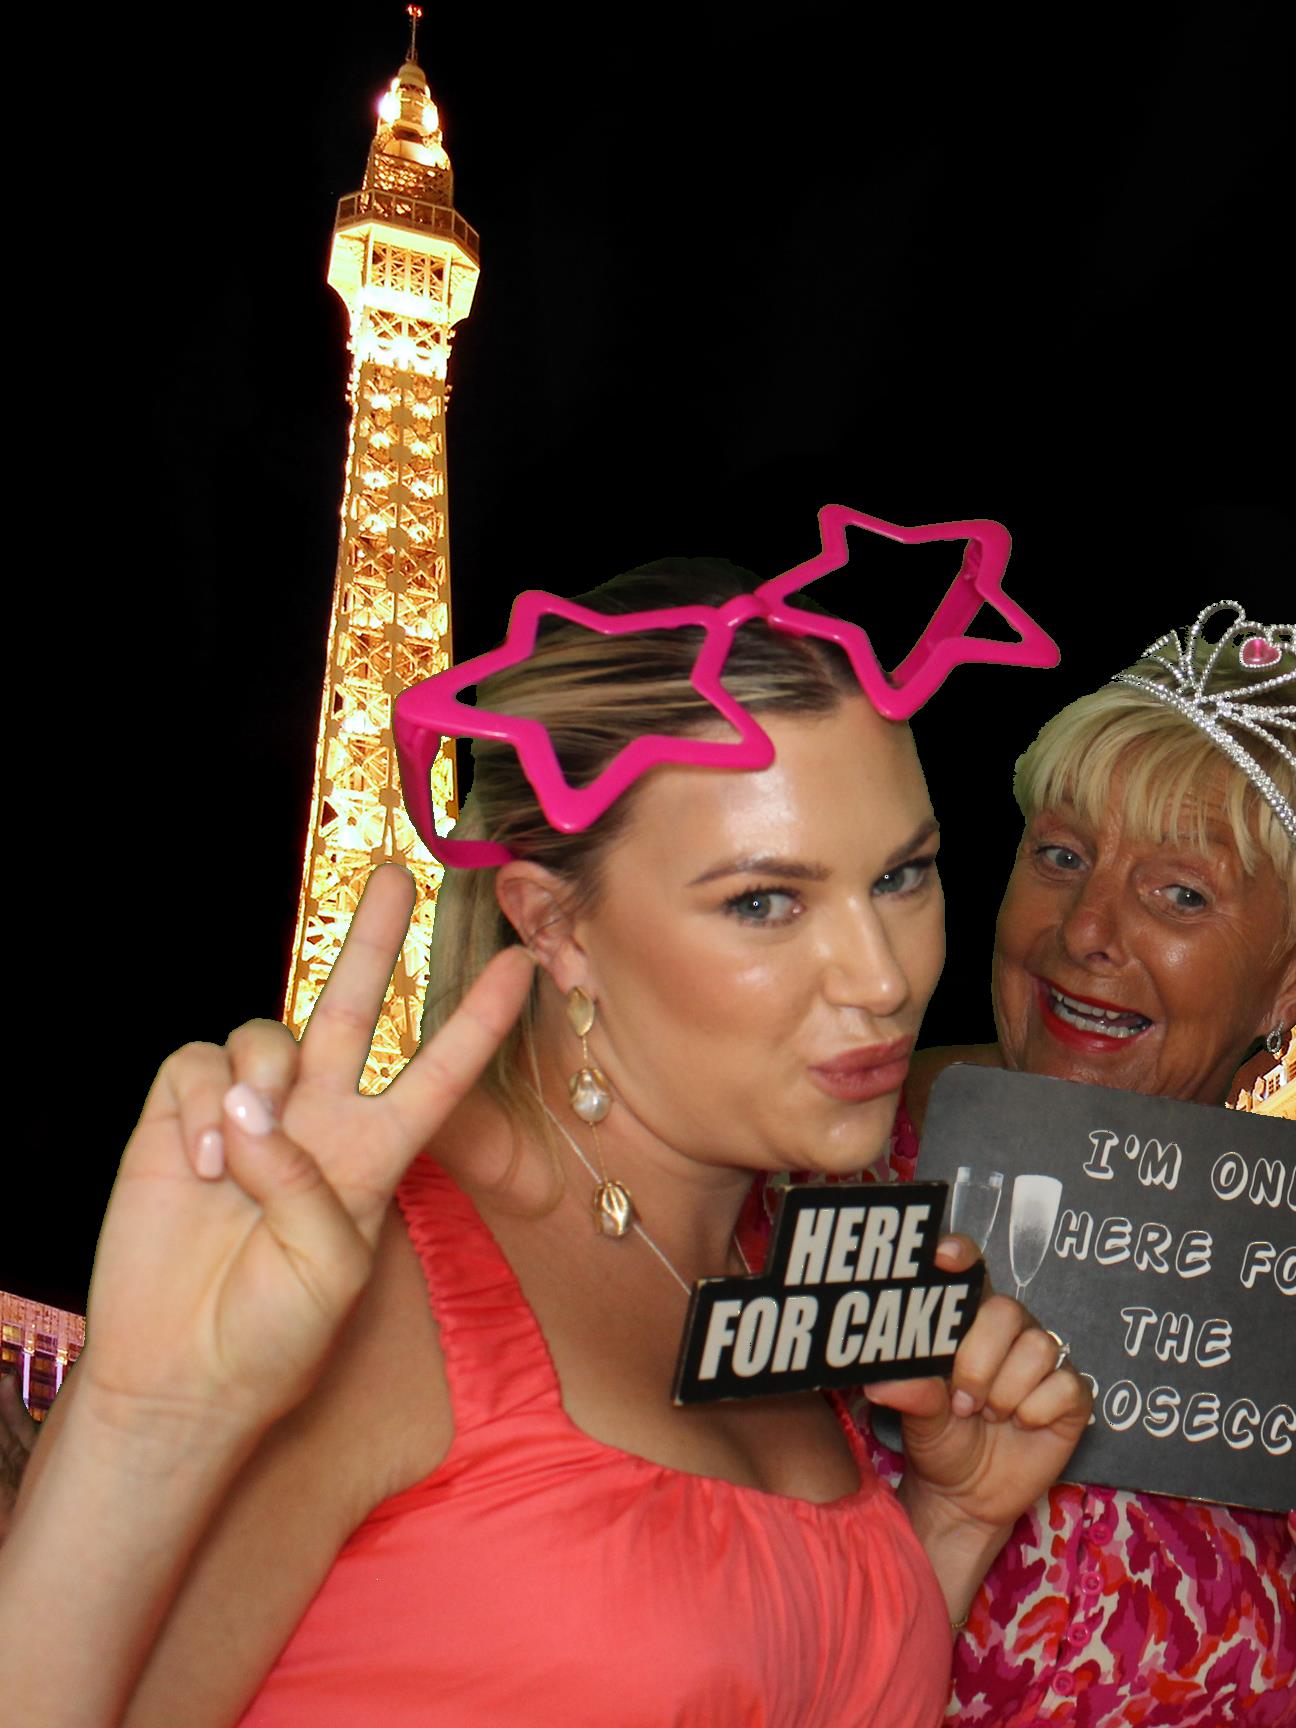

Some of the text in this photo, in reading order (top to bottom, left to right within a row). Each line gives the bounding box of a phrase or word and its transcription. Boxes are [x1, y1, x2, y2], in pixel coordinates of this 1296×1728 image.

[1083, 1130, 1182, 1190] I'M
[784, 1204, 931, 1286] HERE
[1054, 1209, 1213, 1278] HERE
[698, 1284, 969, 1381] FOR CAKE
[1121, 1307, 1232, 1368] THE
